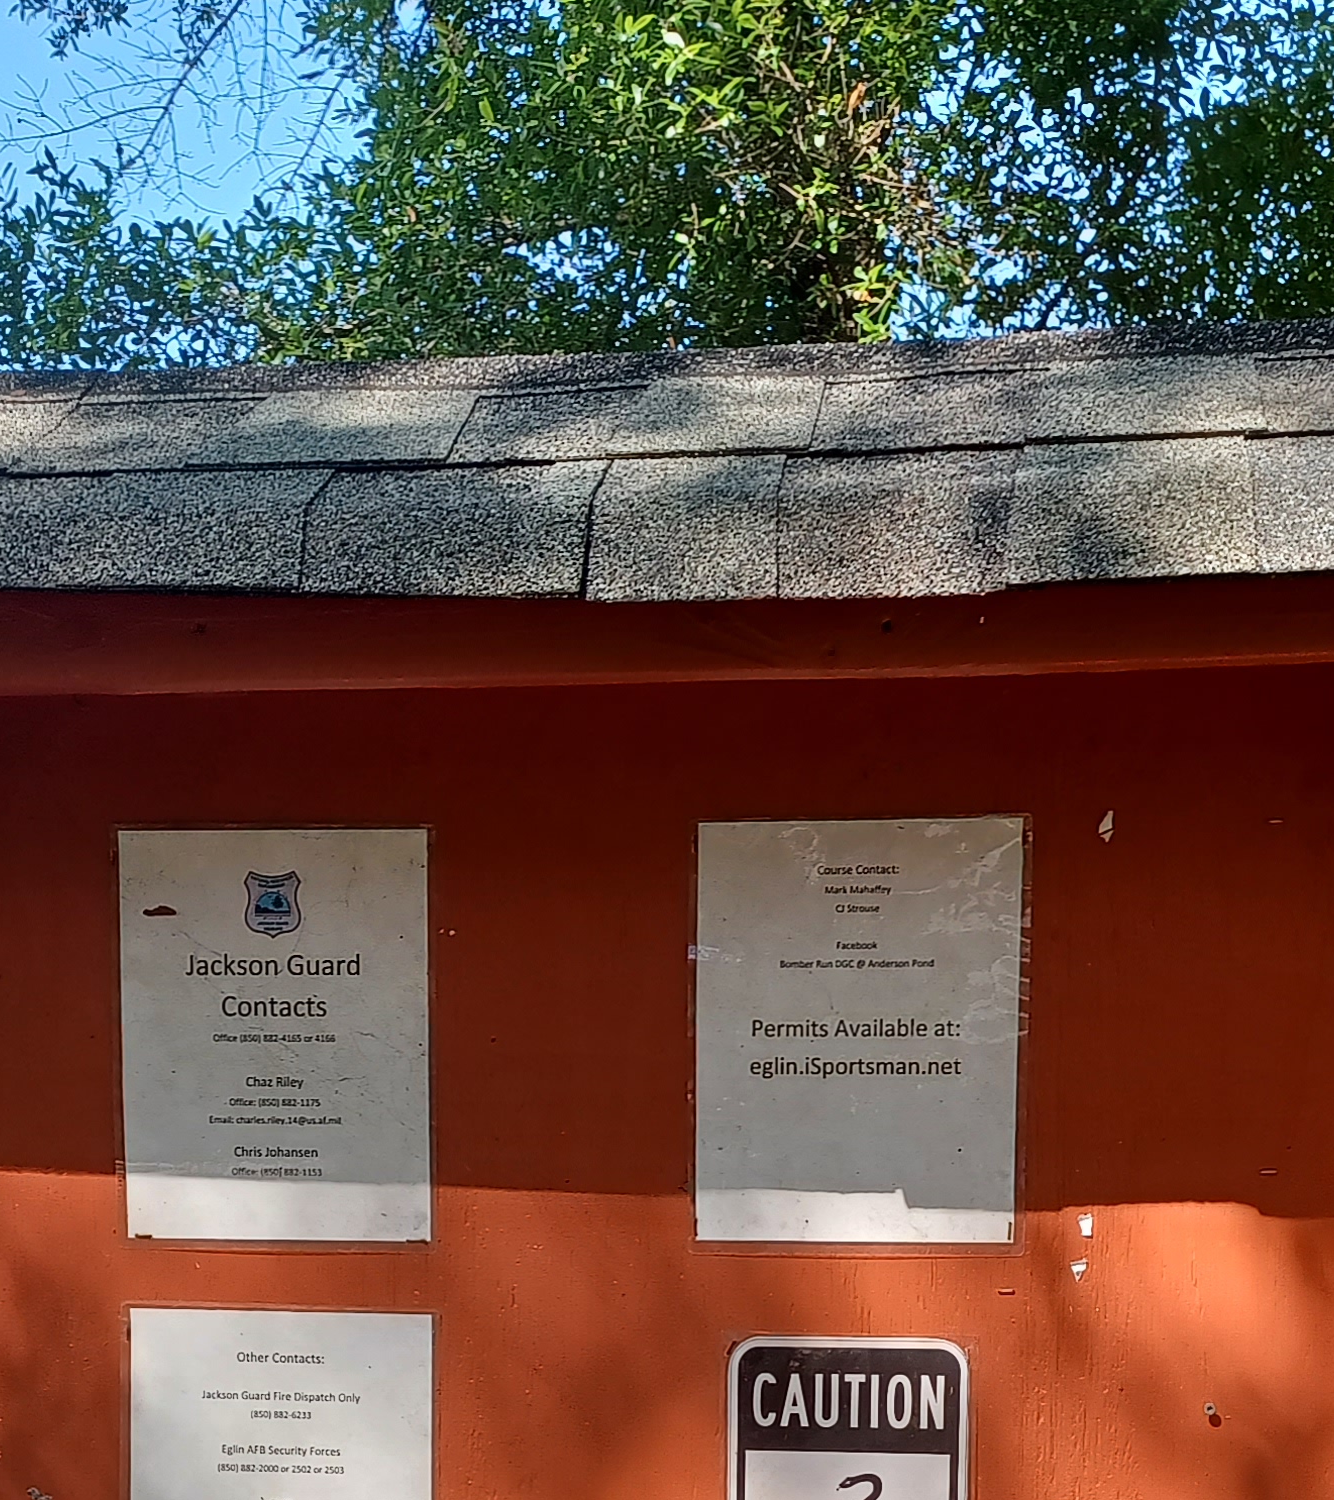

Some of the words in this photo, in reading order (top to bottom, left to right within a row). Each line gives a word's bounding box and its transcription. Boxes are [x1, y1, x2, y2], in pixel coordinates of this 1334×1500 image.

[817, 865, 853, 875] Course
[856, 865, 899, 875] Contact:
[825, 886, 847, 894] Mark
[835, 904, 845, 912] CJ
[847, 904, 880, 912] Strouse
[836, 941, 877, 949] Facebook
[185, 954, 278, 977] Jackson
[287, 953, 361, 977] Guard
[780, 960, 814, 968] Bomber
[816, 960, 833, 968] Run
[835, 960, 854, 968] DGC
[868, 960, 909, 968] Anderson
[912, 959, 935, 967] Pond
[221, 995, 328, 1018] Contacts
[751, 1019, 828, 1037] Permits
[834, 1018, 928, 1037] Available
[934, 1020, 962, 1037] at:
[213, 1034, 237, 1042] Office
[750, 1057, 962, 1079] eglin.iSportsman.net
[246, 1077, 273, 1087] Chaz
[276, 1076, 304, 1089] Riley
[229, 1098, 256, 1106] Office:
[209, 1116, 234, 1124] Email:
[234, 1147, 262, 1157] Chris
[265, 1147, 318, 1158] Johansen
[232, 1167, 258, 1176] Office:
[237, 1352, 269, 1363] Other
[272, 1353, 325, 1364] Contacts:
[202, 1390, 239, 1400] Jackson
[241, 1391, 271, 1401] Guard
[274, 1392, 291, 1401] Fire
[294, 1393, 336, 1404] Dispatch
[339, 1394, 360, 1404] Only
[752, 1372, 946, 1430] CAUTION
[251, 1411, 271, 1420] (850)
[222, 1445, 244, 1456] Eglin
[247, 1445, 266, 1455] AFB
[268, 1445, 307, 1456] Security
[310, 1447, 341, 1456] Forces
[217, 1464, 239, 1473] (850)
[292, 1466, 311, 1474] 2502
[325, 1466, 344, 1474] 2503
